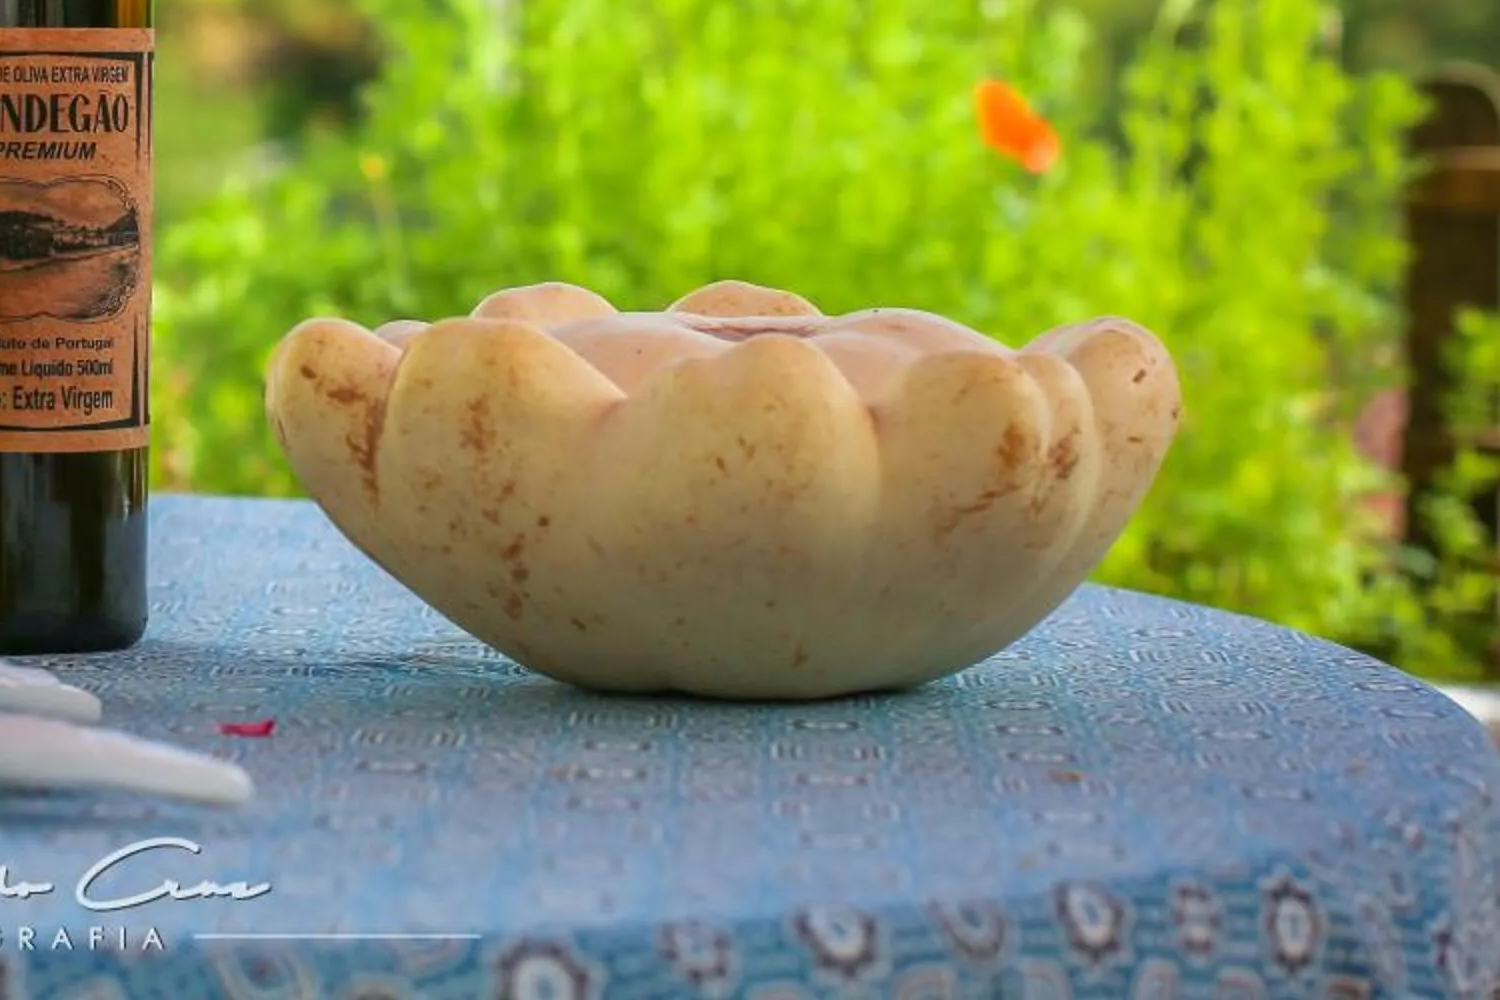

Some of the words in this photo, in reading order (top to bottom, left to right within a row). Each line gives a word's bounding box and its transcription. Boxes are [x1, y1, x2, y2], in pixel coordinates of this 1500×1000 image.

[13, 66, 48, 83] OLIVA
[51, 66, 89, 84] EXTRA
[92, 66, 129, 83] VIRGEM
[30, 337, 49, 349] de
[55, 337, 114, 352] Portugal
[77, 358, 113, 376] 500ml
[13, 387, 56, 409] Extra
[61, 385, 113, 415] Virgem
